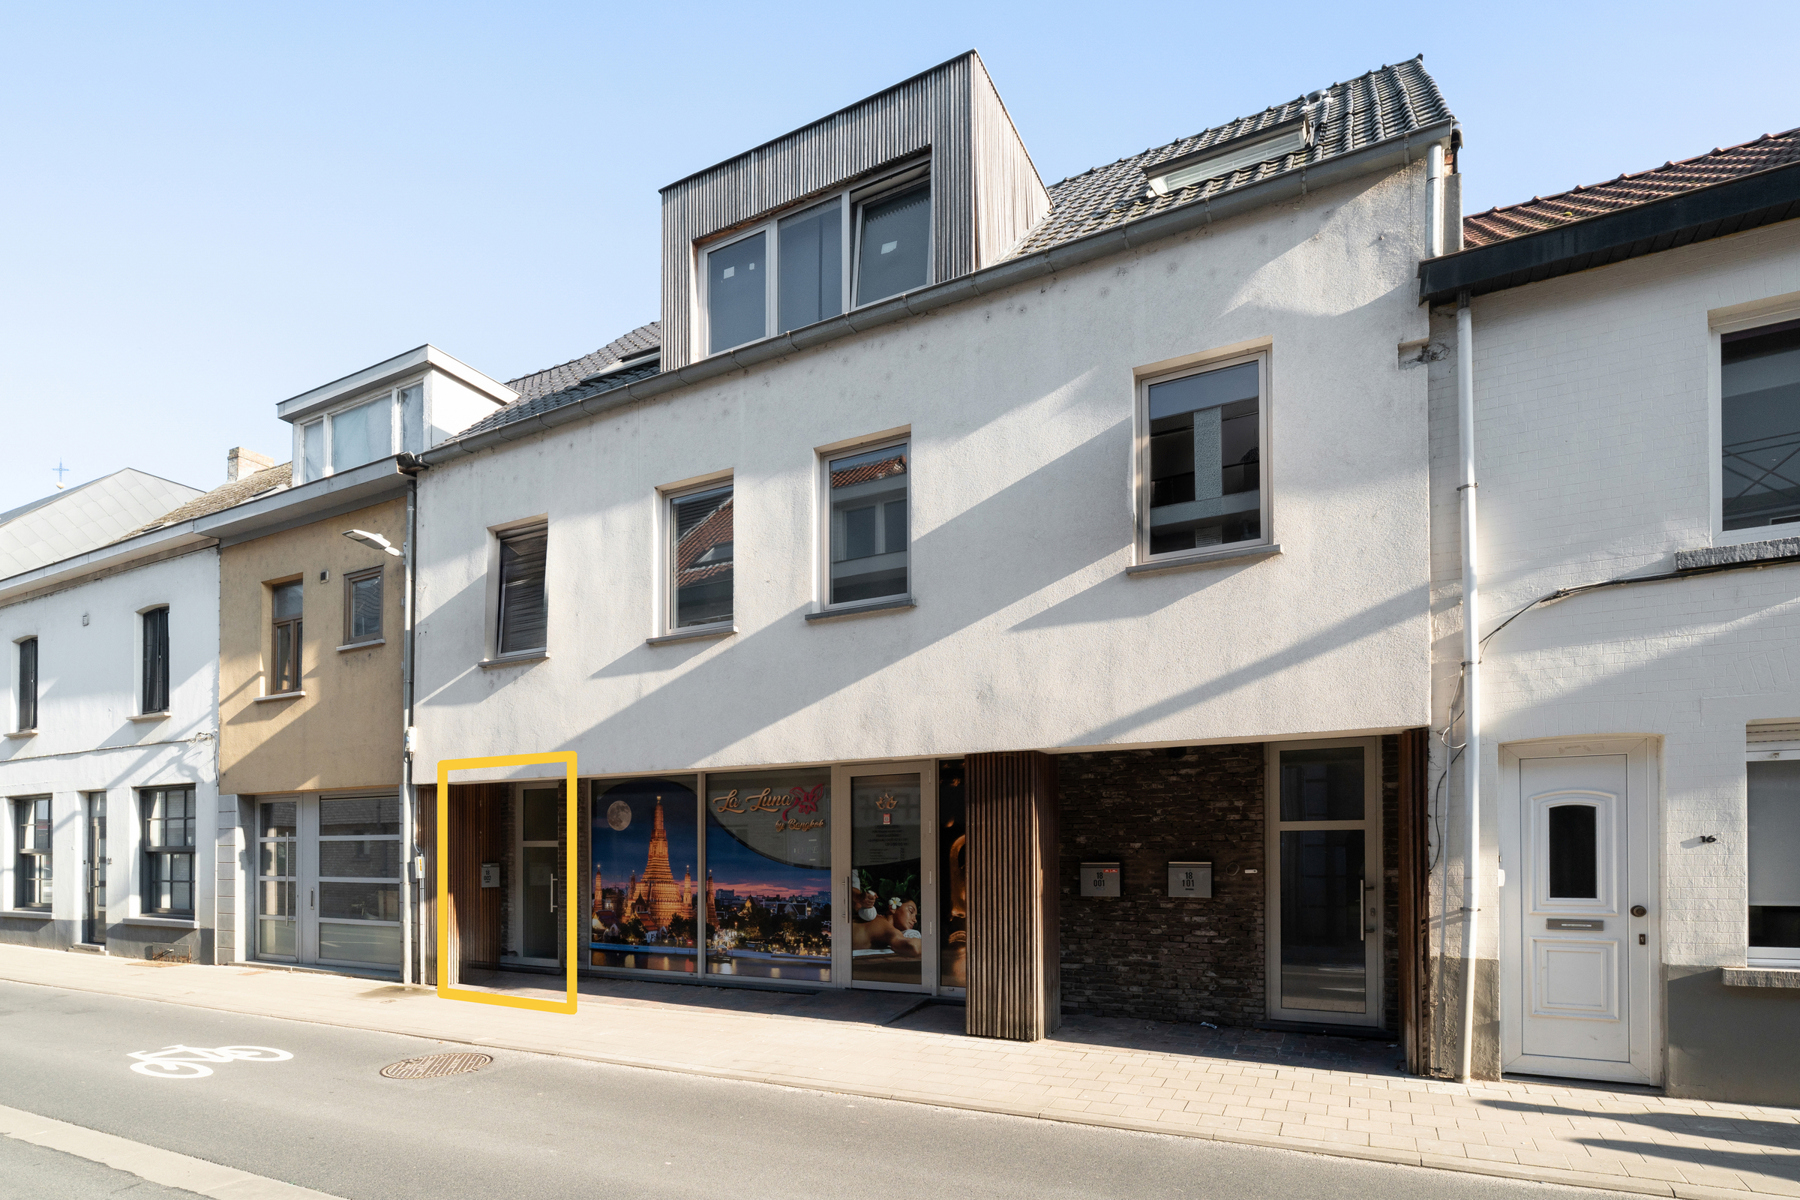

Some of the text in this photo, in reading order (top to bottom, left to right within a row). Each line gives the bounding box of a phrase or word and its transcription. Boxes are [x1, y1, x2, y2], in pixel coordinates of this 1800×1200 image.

[713, 787, 792, 814] La Luna
[775, 818, 825, 832] by Bangkok
[1700, 835, 1717, 843] 16
[1093, 879, 1105, 887] 001
[1182, 879, 1195, 887] 101
